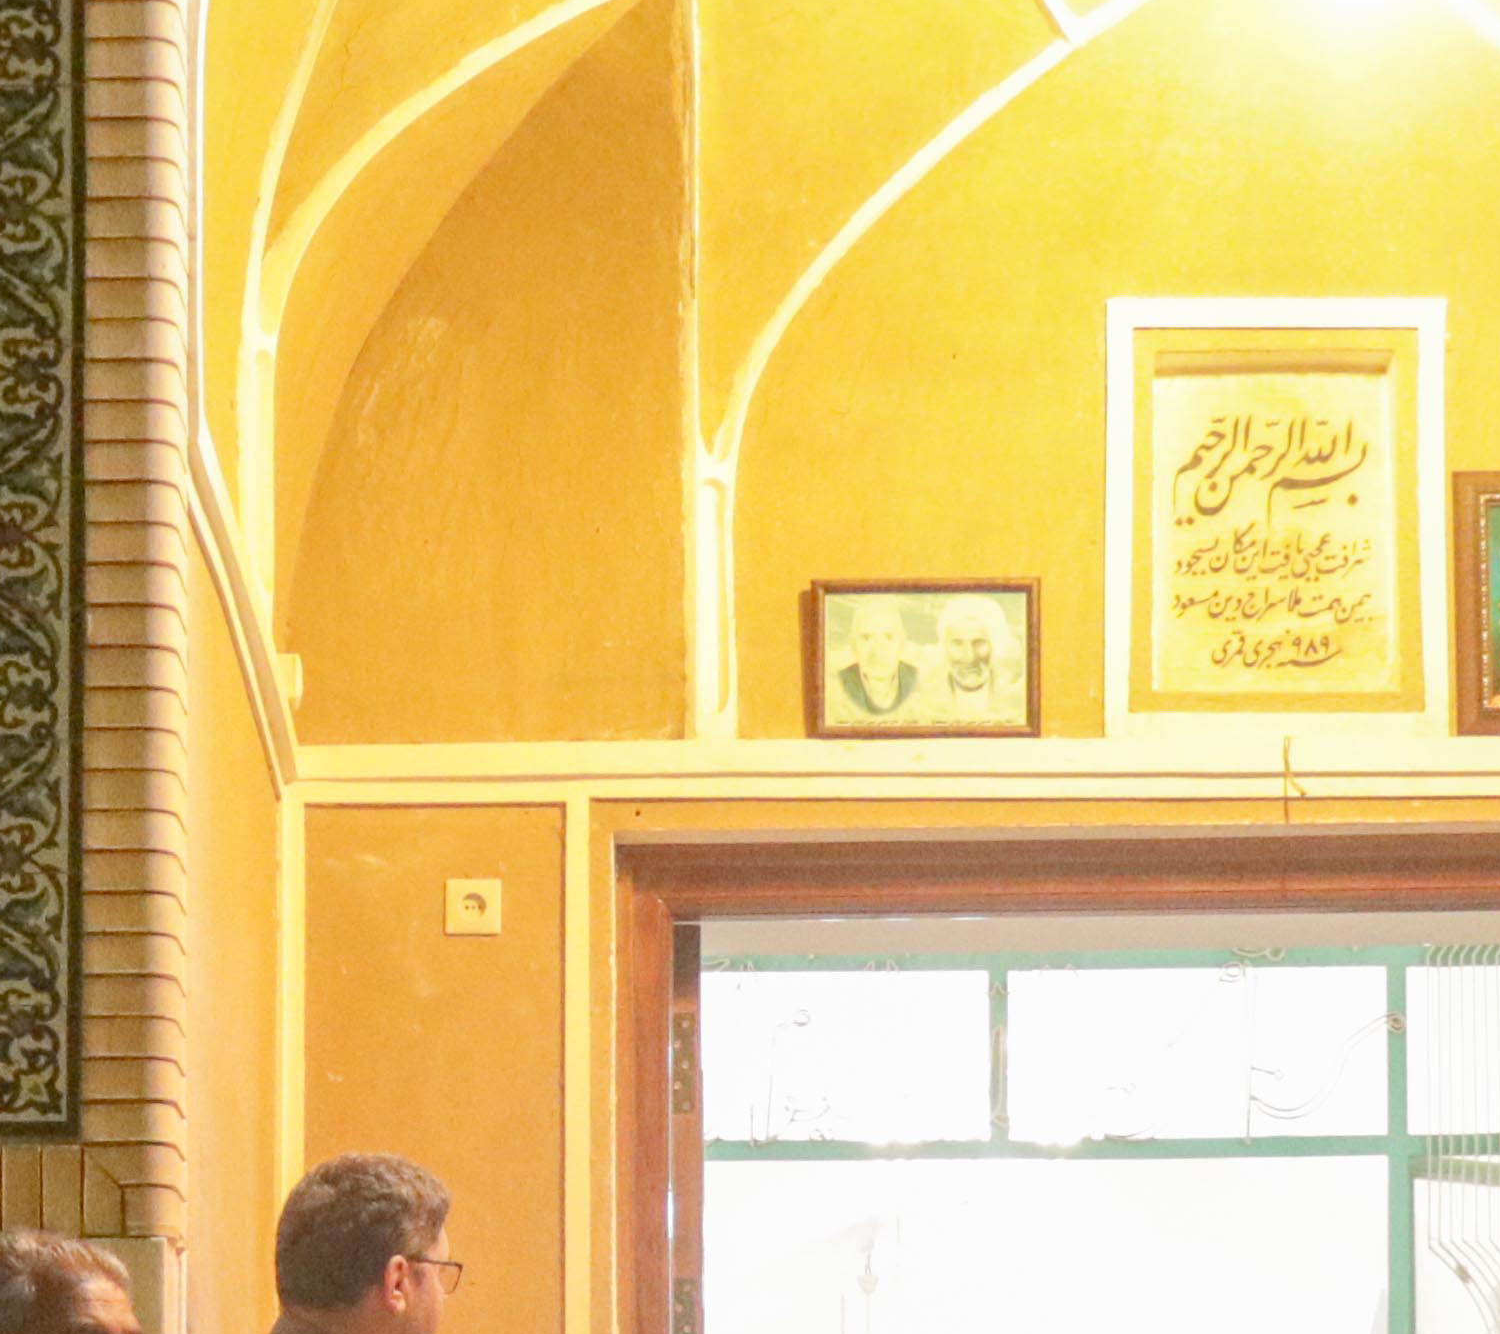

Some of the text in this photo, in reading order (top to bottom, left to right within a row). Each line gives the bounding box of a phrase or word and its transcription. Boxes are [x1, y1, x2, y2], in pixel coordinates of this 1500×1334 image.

[1194, 417, 1307, 517] الرحمن
[1267, 442, 1369, 527] بسم
[1293, 419, 1353, 468] الله
